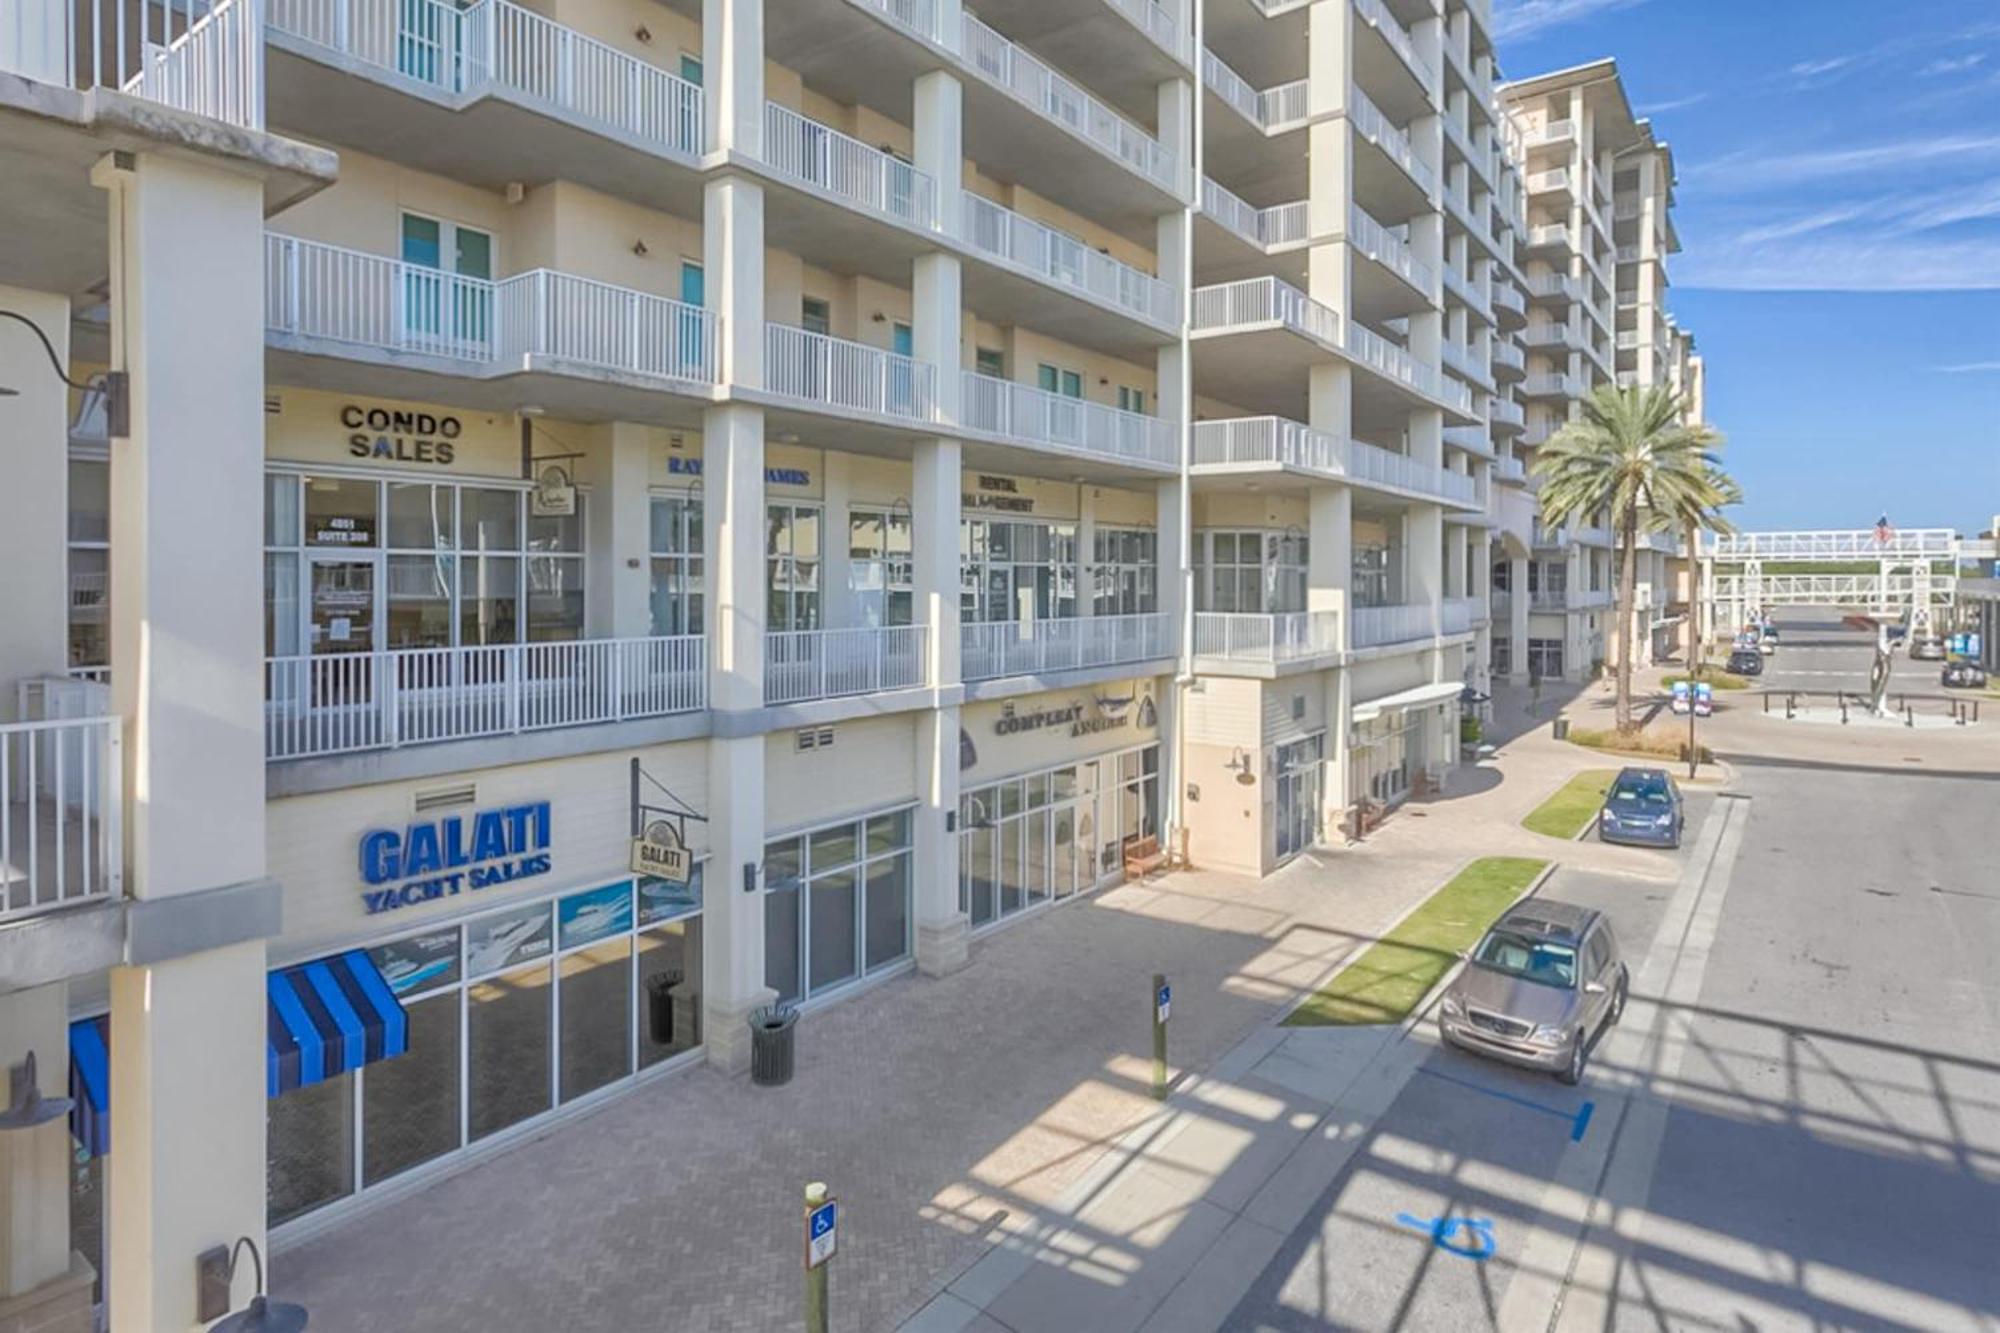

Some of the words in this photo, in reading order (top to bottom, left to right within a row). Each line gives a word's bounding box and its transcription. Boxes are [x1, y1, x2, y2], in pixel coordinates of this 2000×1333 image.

[341, 405, 462, 440] CONDO
[350, 433, 455, 466] SALES
[359, 801, 552, 886] GALATI
[641, 844, 681, 868] GALATI
[361, 872, 465, 915] YACHT
[469, 853, 552, 890] SALES
